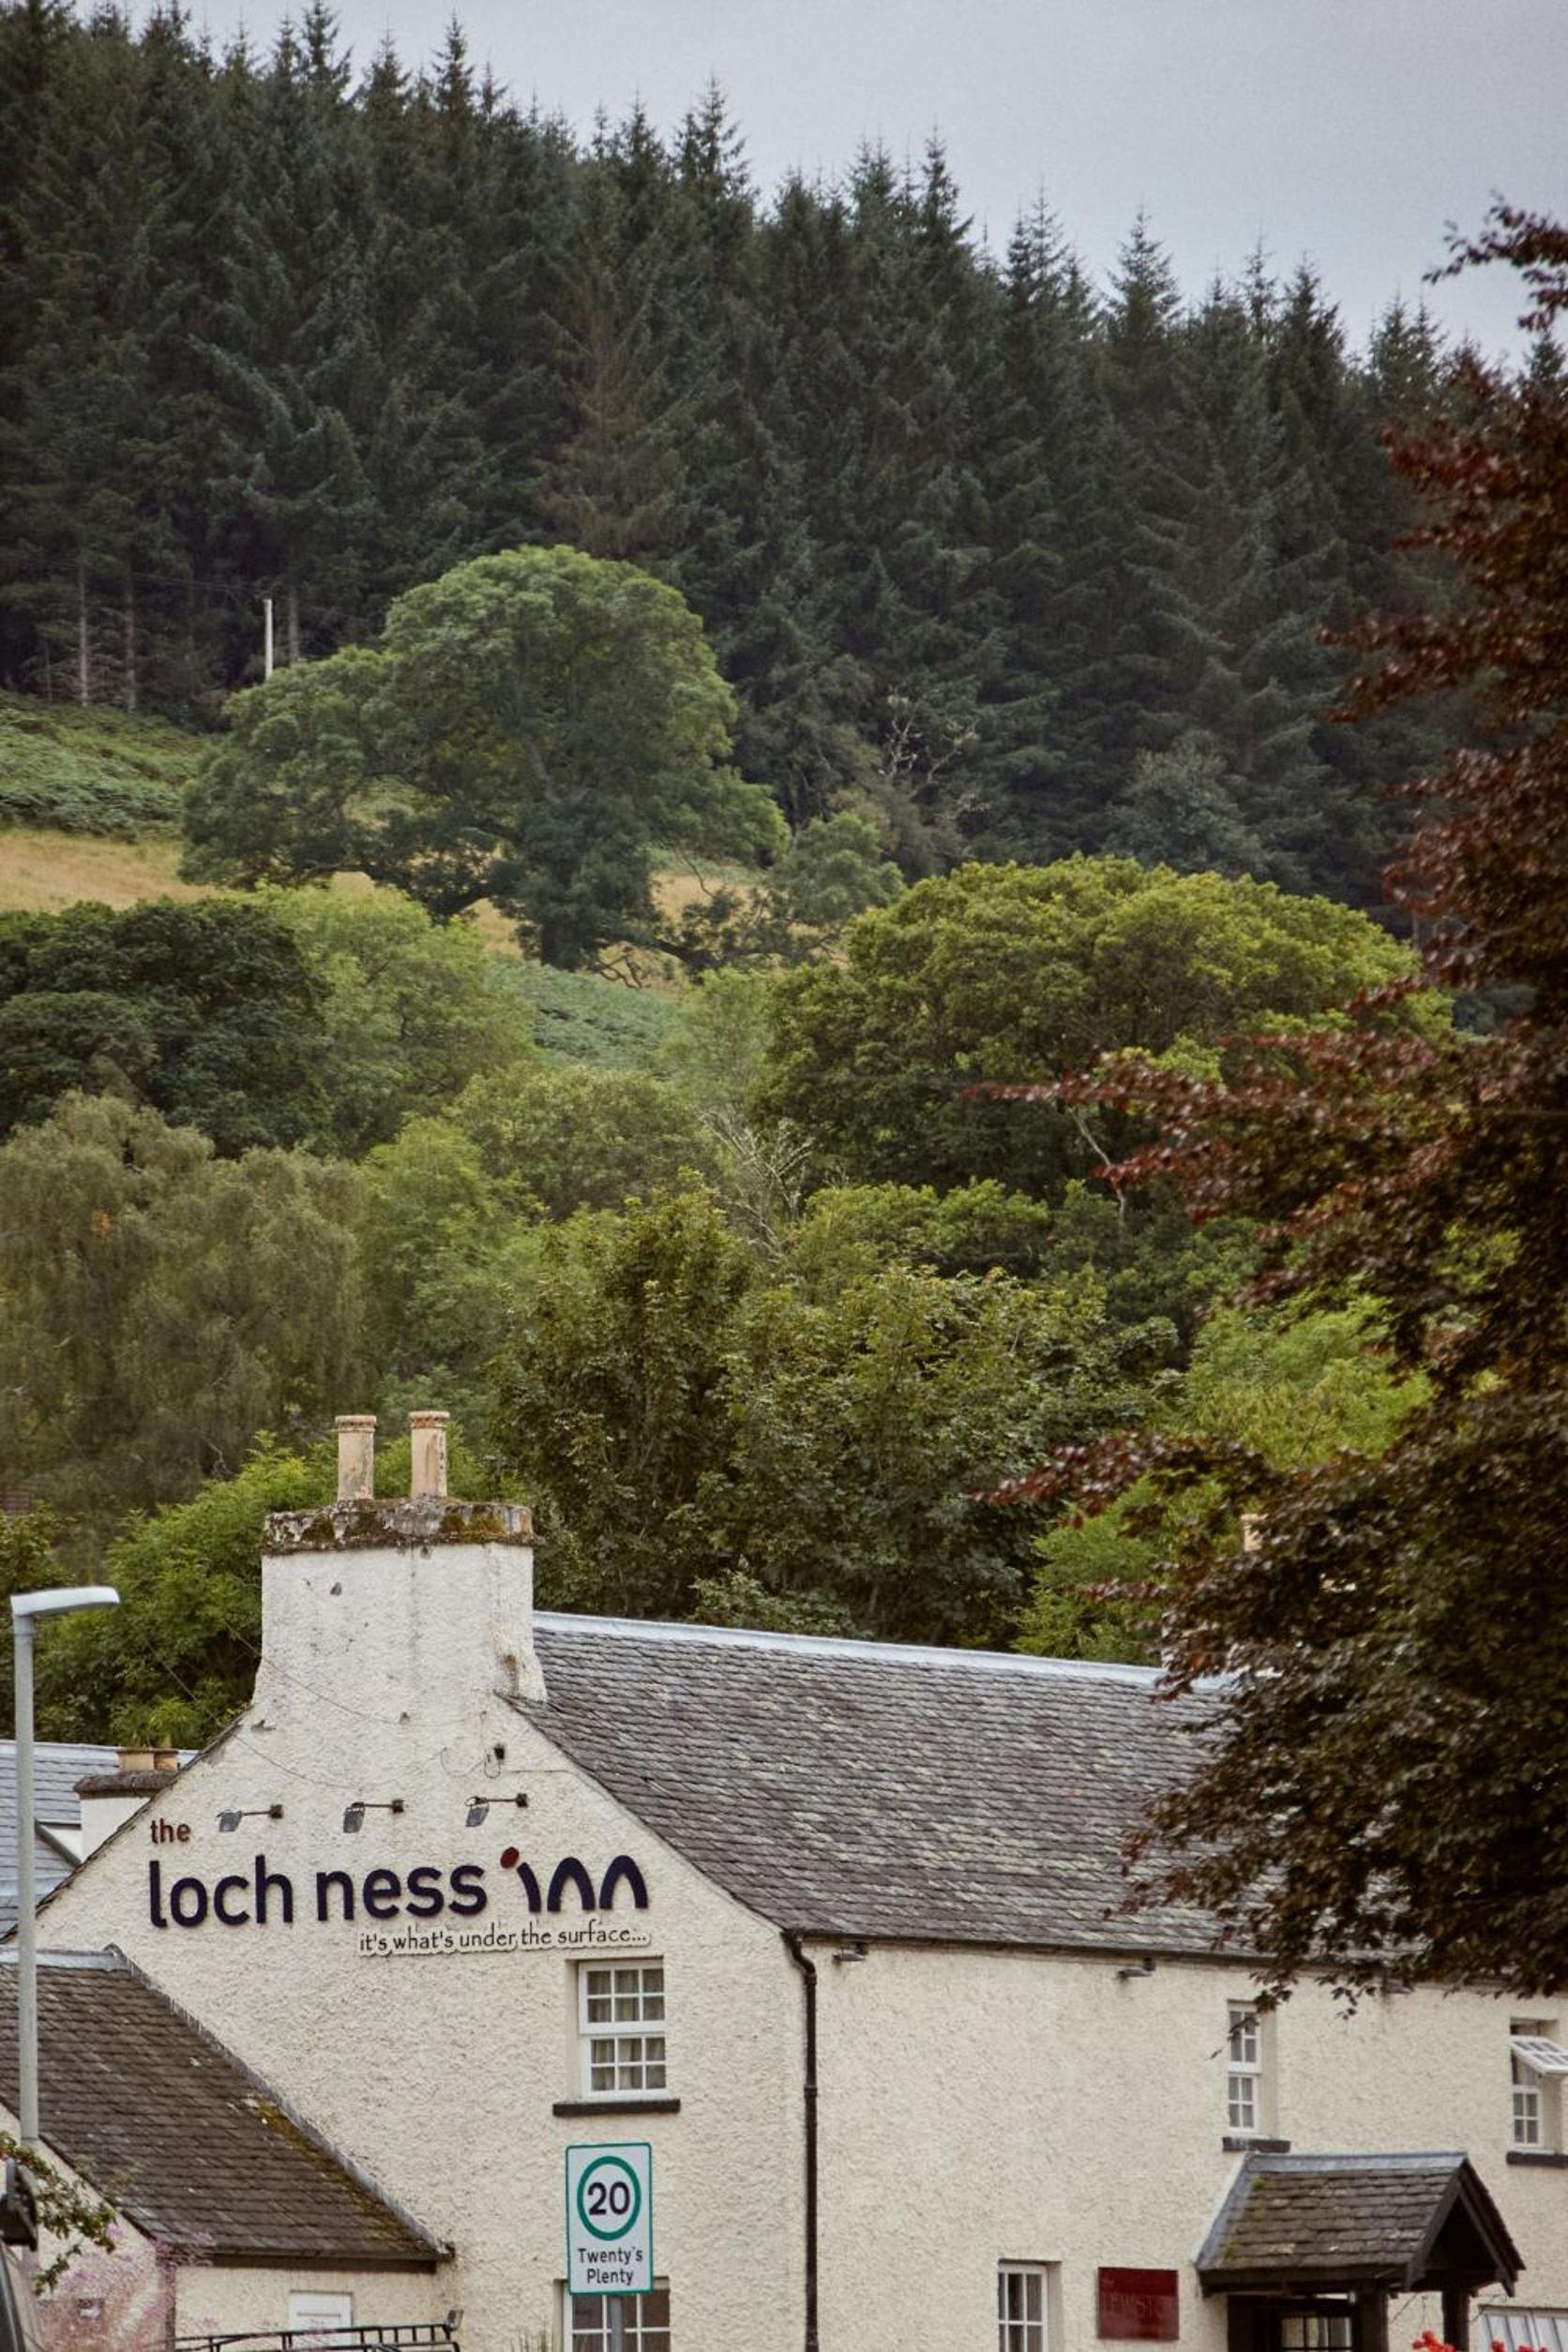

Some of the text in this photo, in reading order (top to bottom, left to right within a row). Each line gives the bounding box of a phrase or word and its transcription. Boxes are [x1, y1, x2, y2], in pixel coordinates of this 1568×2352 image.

[150, 1817, 190, 1845] the
[149, 1847, 649, 1928] loch ness inn
[359, 1919, 647, 1952] it's what's under the surface...
[588, 2181, 630, 2215] 20
[578, 2247, 643, 2265] Twenty's
[586, 2269, 635, 2285] Plenty
